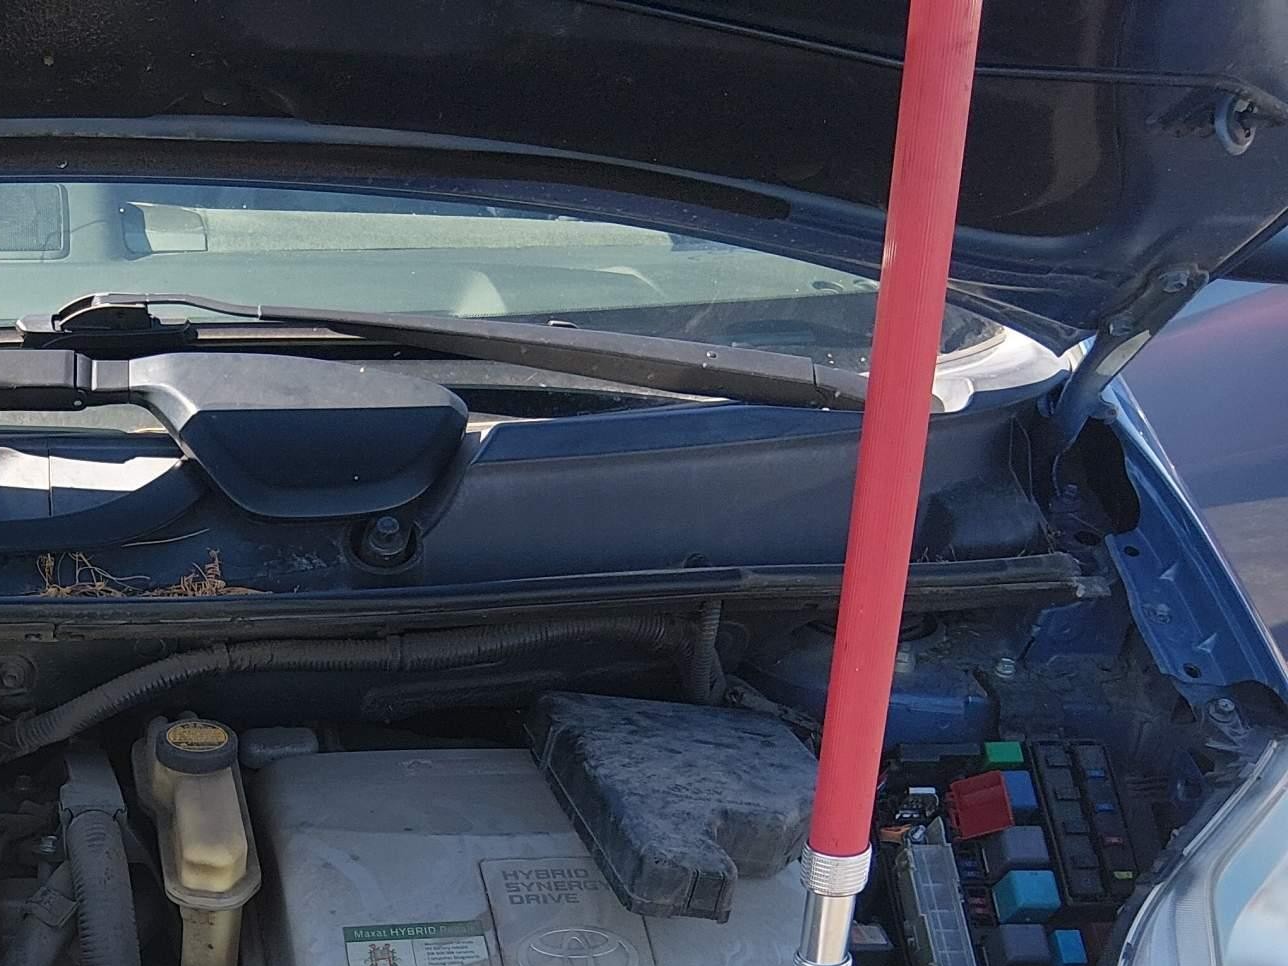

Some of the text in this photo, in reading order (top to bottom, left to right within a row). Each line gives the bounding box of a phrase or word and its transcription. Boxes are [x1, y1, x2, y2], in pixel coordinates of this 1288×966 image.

[502, 868, 589, 881] HYBRID
[505, 880, 610, 893] SYNERGY
[509, 893, 580, 905] DRIVE
[390, 925, 436, 937] HYBRID
